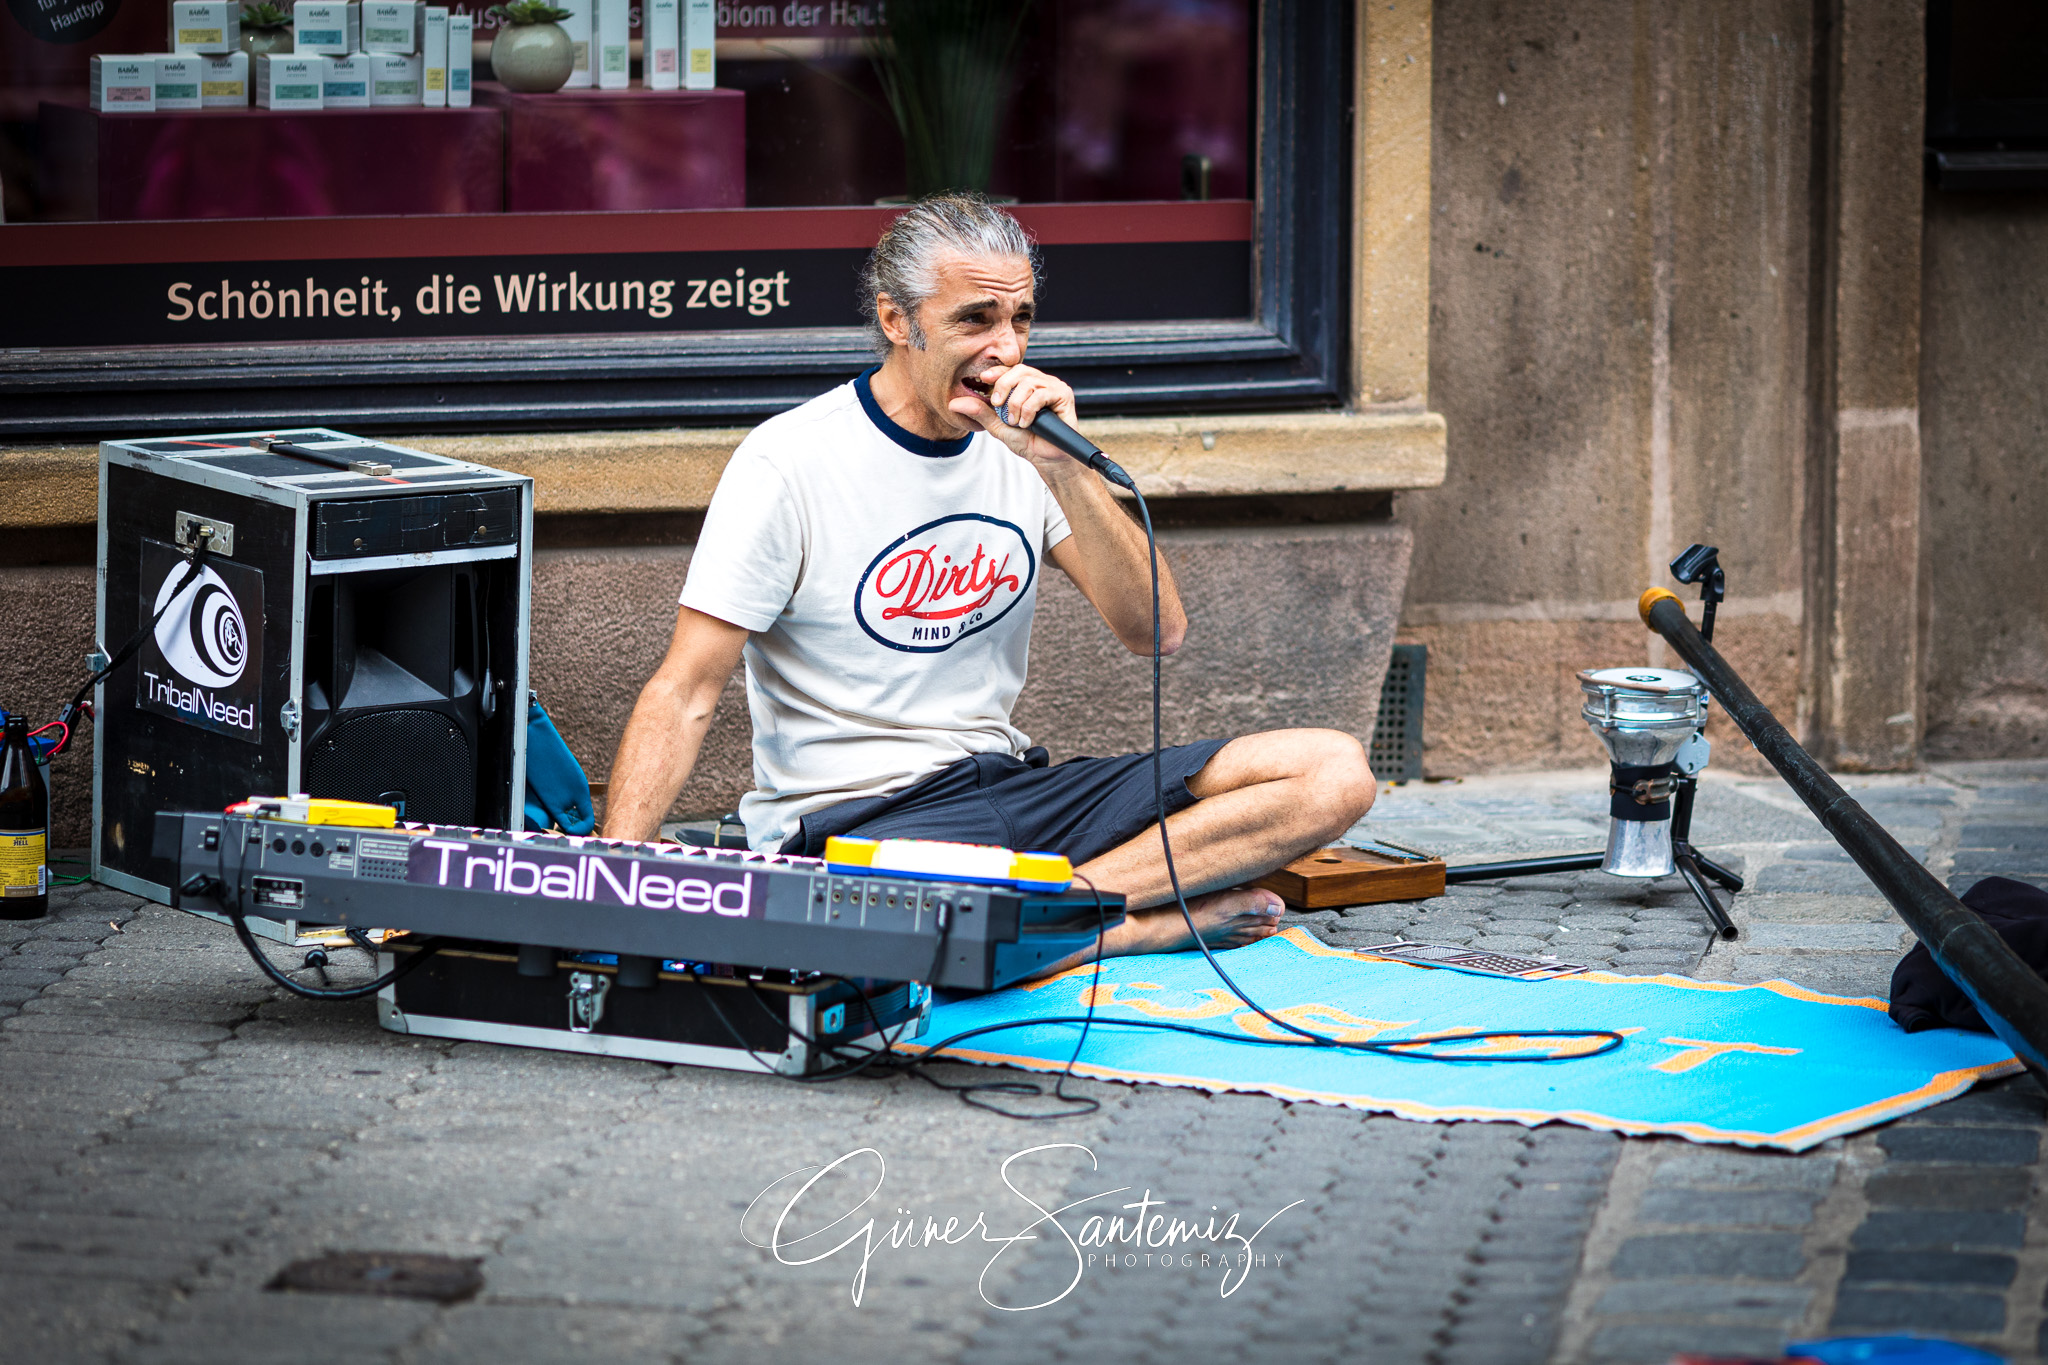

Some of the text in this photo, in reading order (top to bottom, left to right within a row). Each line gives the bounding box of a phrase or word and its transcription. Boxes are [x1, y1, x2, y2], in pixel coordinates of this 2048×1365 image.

[50, 0, 104, 32] Hauttyp
[783, 0, 824, 27] der
[167, 268, 790, 321] Schönheit, die Wirkung zeigt
[876, 543, 1019, 621] Dirty
[912, 626, 950, 641] MIND
[969, 612, 983, 625] CO
[144, 671, 254, 731] TribalNeed
[422, 841, 752, 918] TribalNeed
